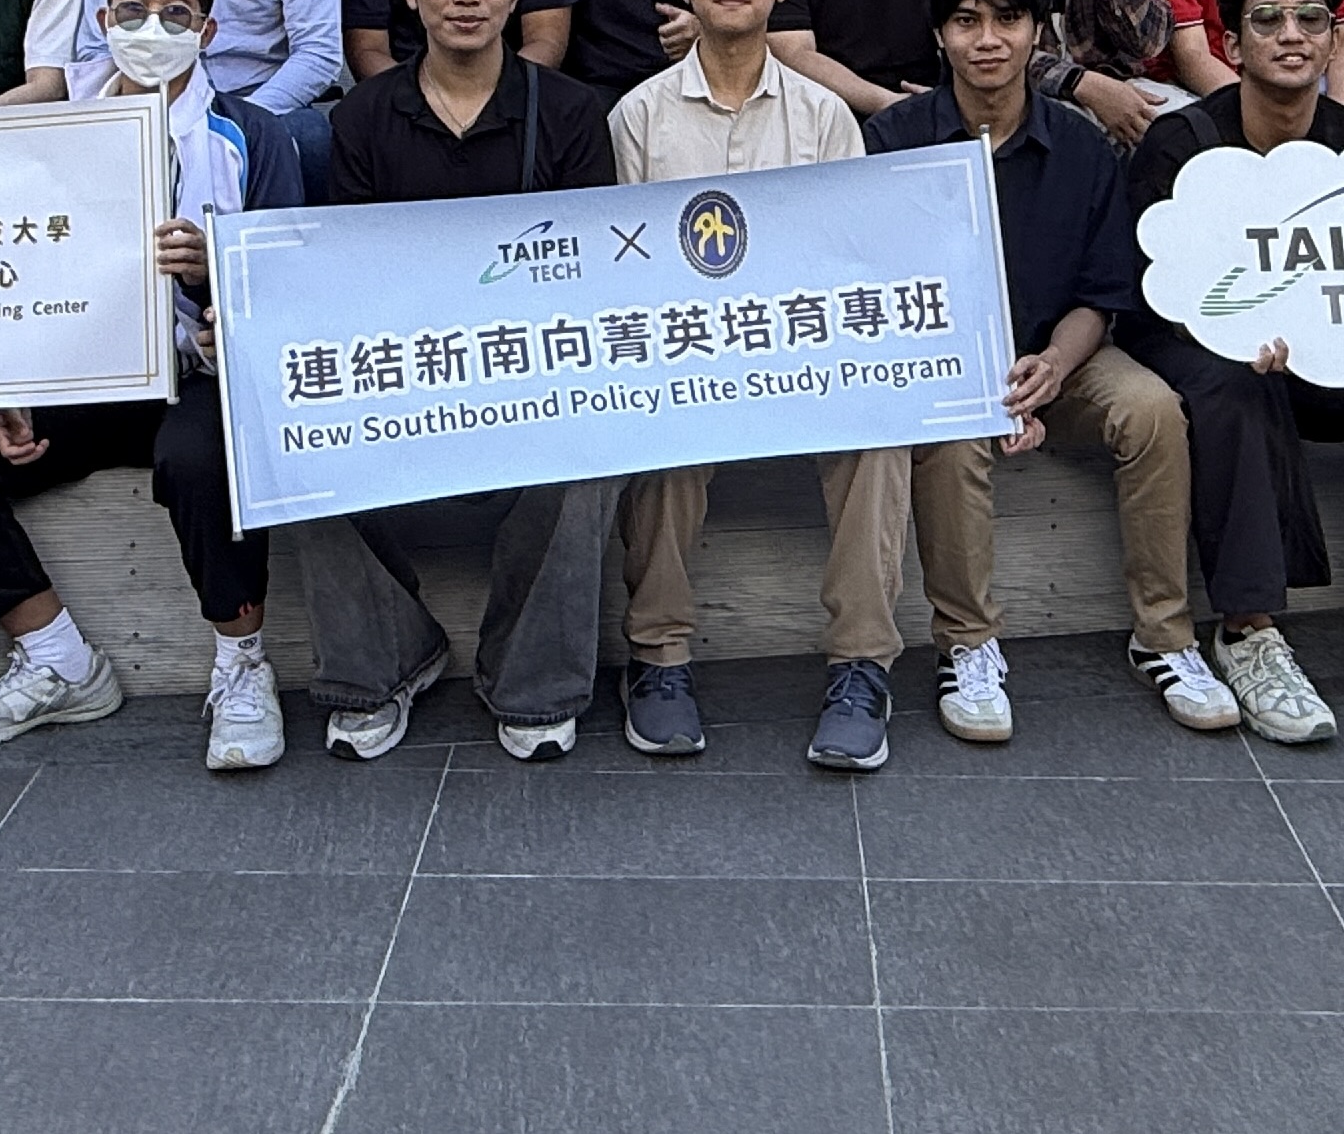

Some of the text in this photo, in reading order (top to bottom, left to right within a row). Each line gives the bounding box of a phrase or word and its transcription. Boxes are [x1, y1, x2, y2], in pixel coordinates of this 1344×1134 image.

[498, 236, 580, 264] TAIPEI
[529, 261, 582, 283] TECH
[32, 299, 89, 316] Center
[285, 281, 948, 402] 連結新南向菁英培育專班
[283, 356, 963, 452] New Southbound Policy Elite Study Program
